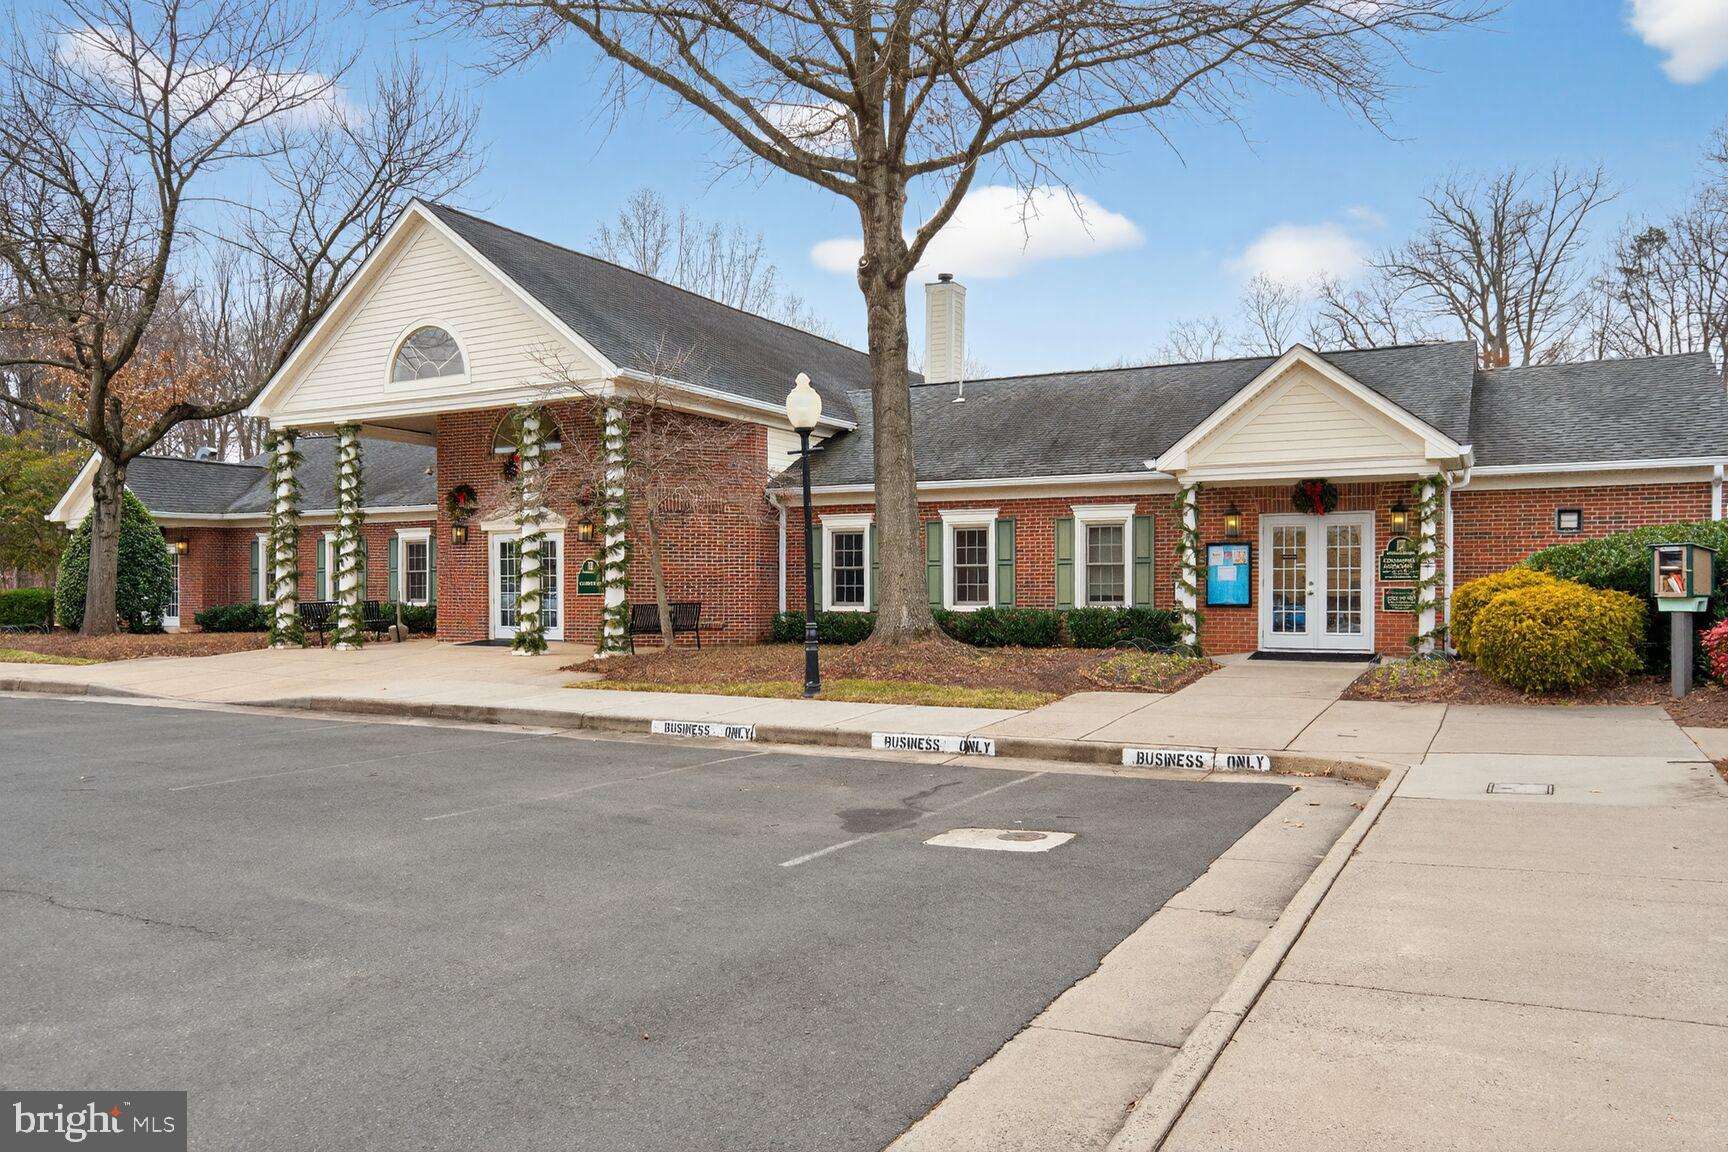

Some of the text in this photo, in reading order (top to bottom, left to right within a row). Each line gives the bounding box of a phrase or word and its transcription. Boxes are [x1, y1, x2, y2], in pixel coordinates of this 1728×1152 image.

[664, 722, 751, 740] BUSINESS ONLY
[884, 736, 991, 754] BUSINESS ONLY
[1136, 751, 1264, 770] BUSINESS ONLY
